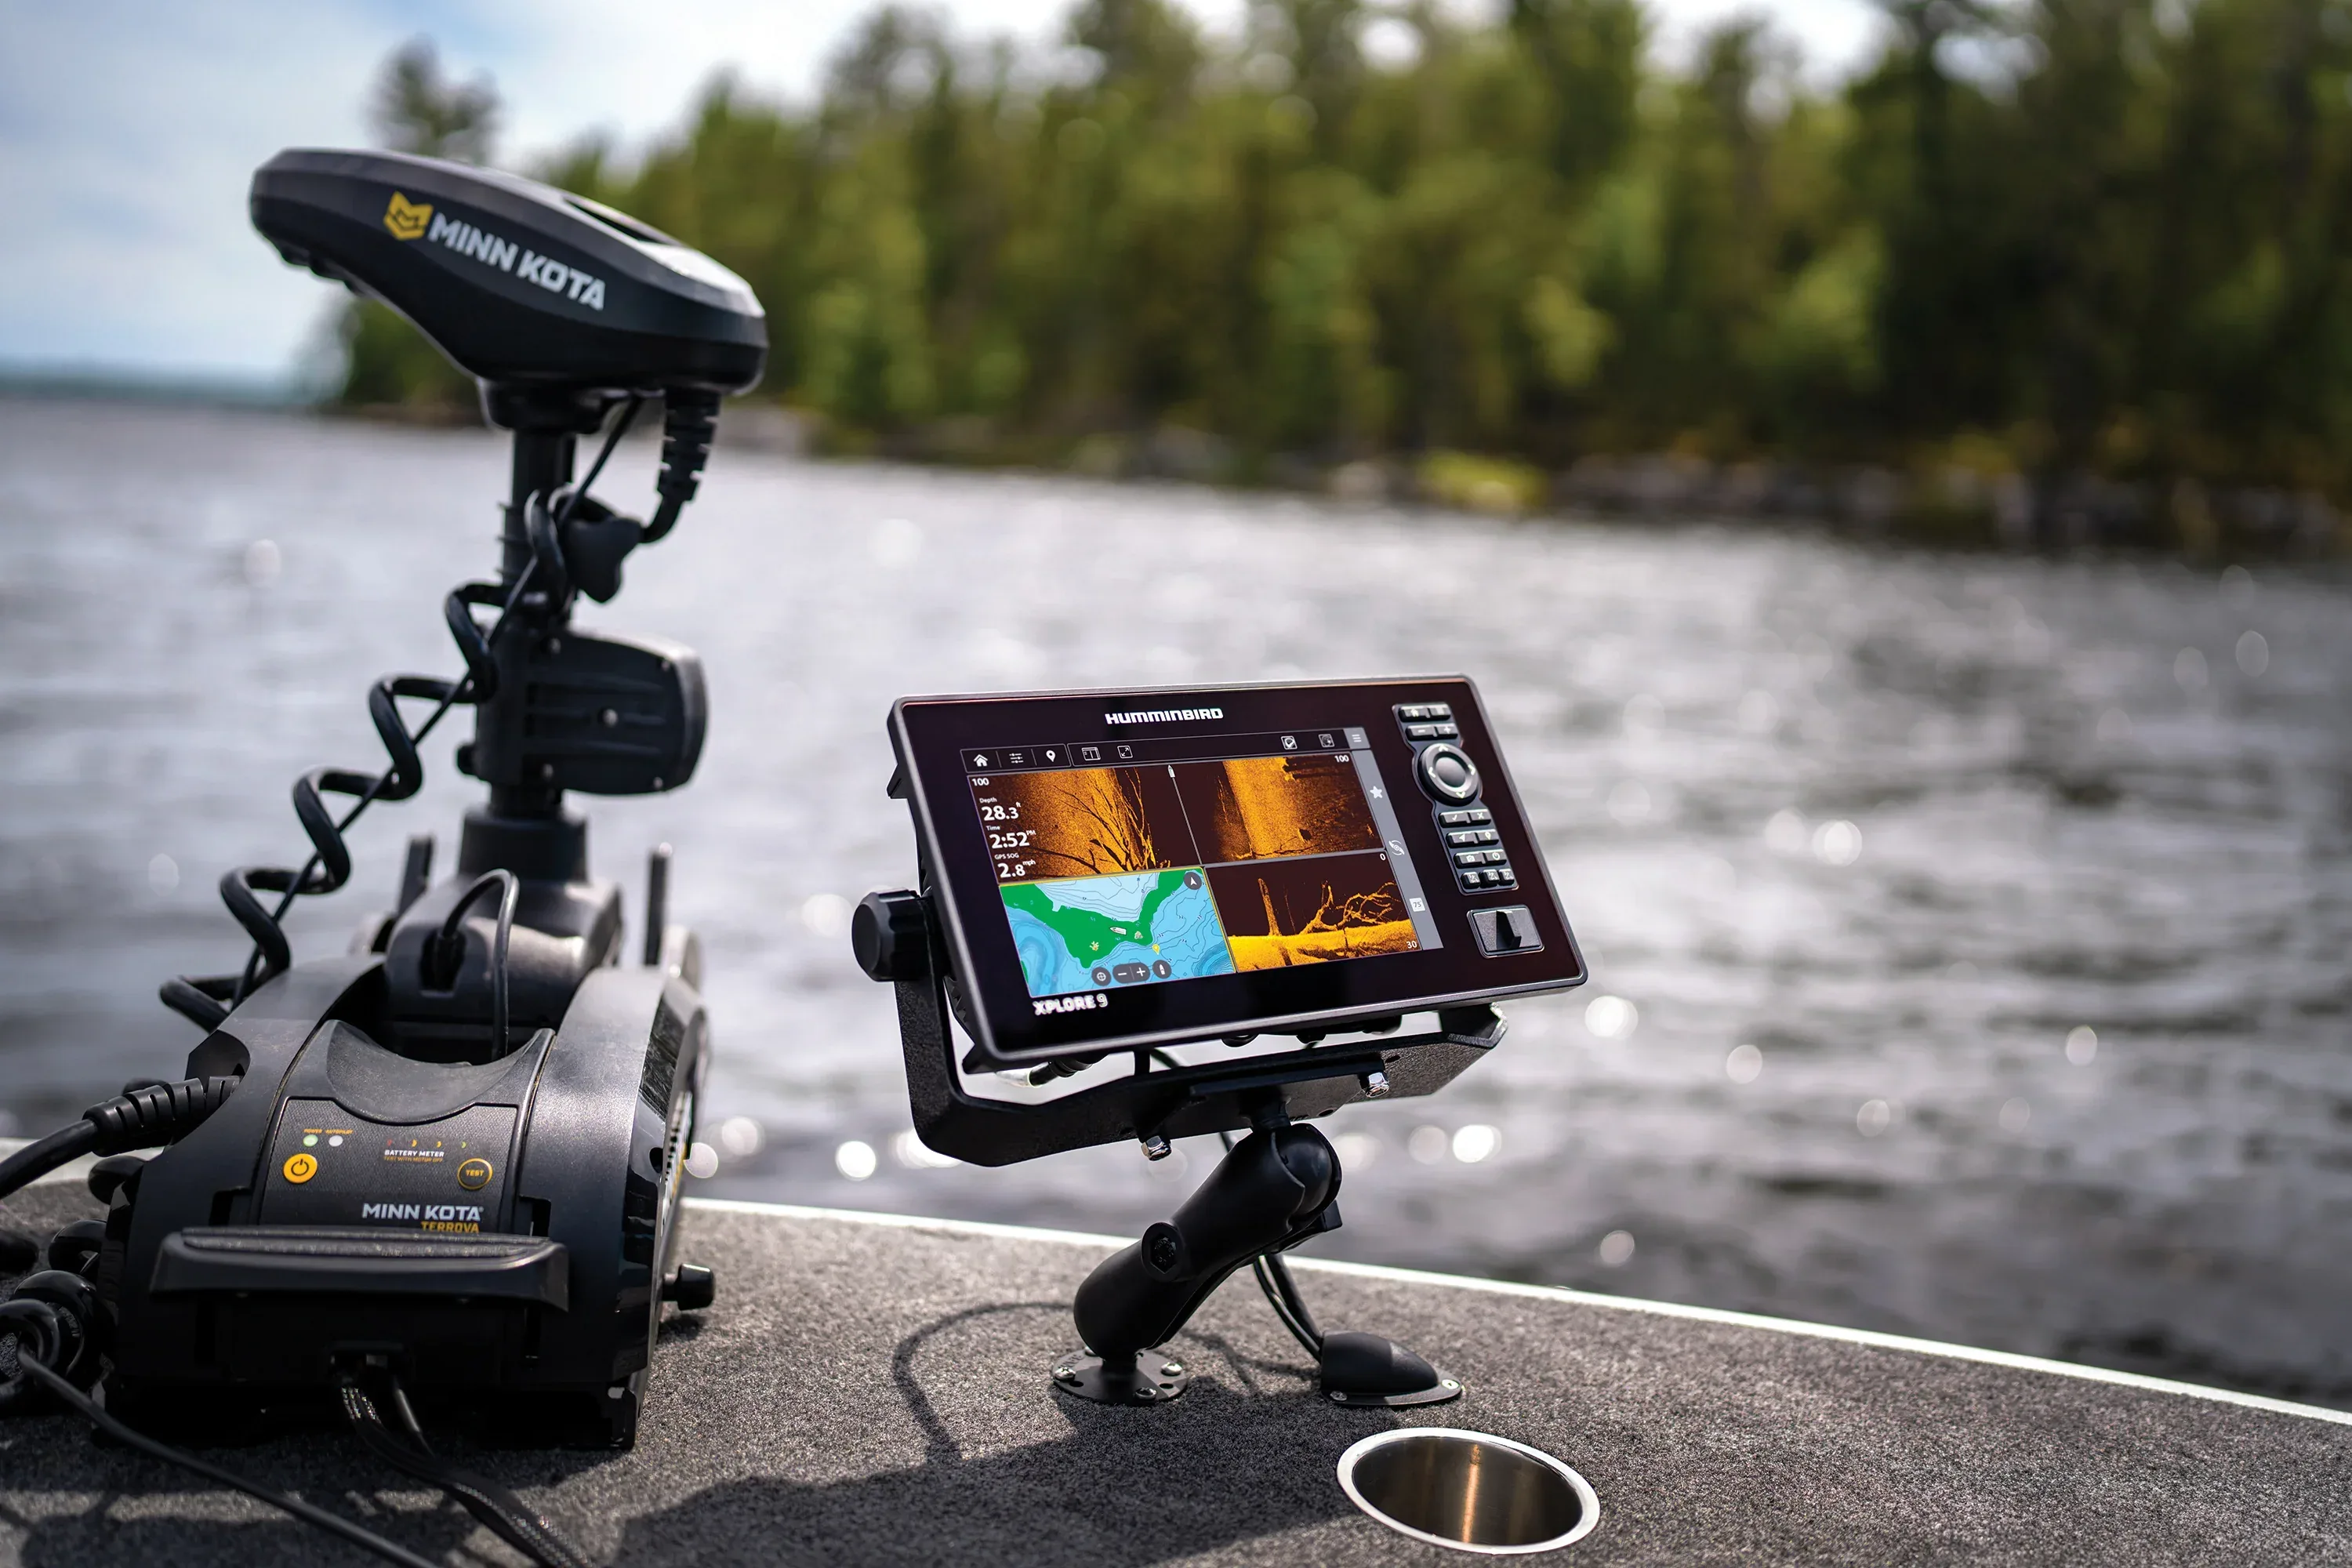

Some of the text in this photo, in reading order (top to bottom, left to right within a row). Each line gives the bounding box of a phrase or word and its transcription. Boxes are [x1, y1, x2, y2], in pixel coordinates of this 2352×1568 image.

[428, 212, 606, 311] MINN KOTA
[1105, 708, 1224, 724] HUMMINBIRD
[1334, 754, 1349, 764] 100
[971, 777, 990, 786] 100
[981, 805, 1019, 822] 28.3
[989, 831, 1030, 849] 2:52
[997, 862, 1025, 878] 2.8
[1406, 940, 1417, 949] 30
[1032, 993, 1109, 1016] XPLORE 9
[361, 1203, 420, 1220] MINN
[420, 1221, 480, 1234] TERROVA
